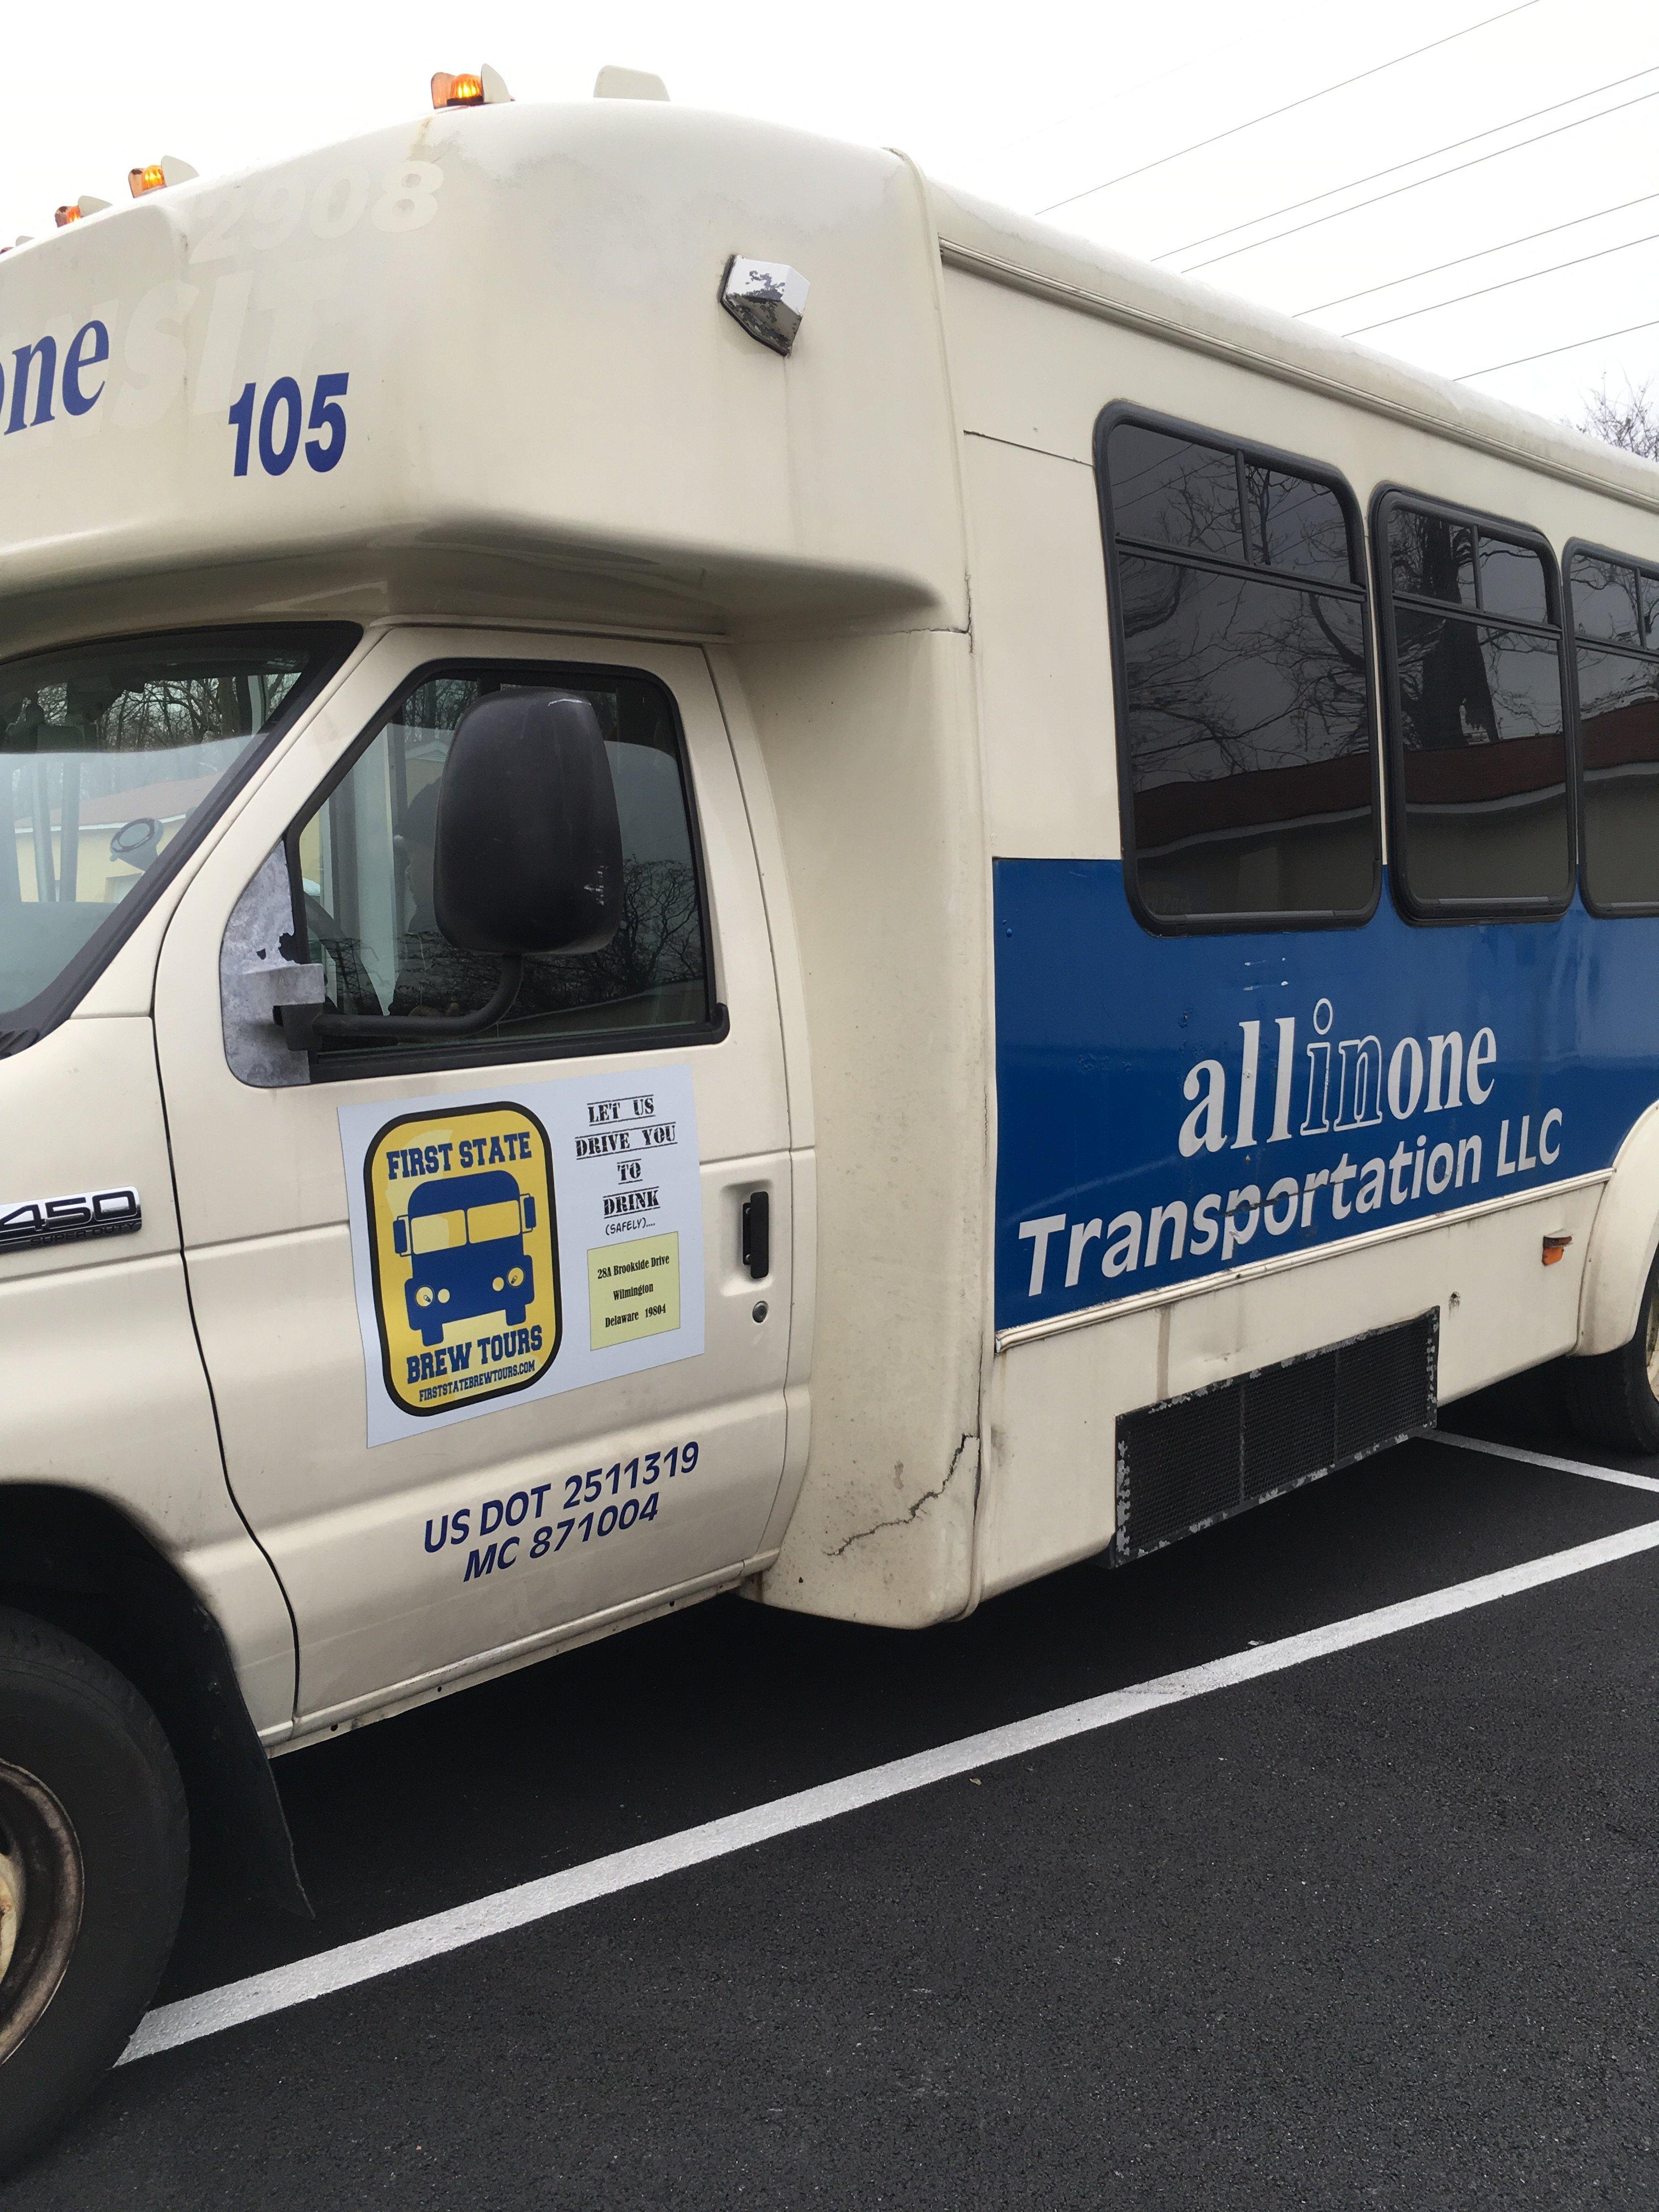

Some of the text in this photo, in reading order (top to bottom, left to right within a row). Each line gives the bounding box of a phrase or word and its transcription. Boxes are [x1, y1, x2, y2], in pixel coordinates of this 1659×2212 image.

[0, 320, 110, 436] ne
[228, 372, 349, 477] 105
[588, 1097, 654, 1123] LET US
[386, 1131, 532, 1180] FIRST STATE
[575, 1125, 675, 1157] DRIVE YOU
[617, 1162, 641, 1181] TO
[603, 1189, 659, 1216] DRINK
[1019, 1108, 1563, 1297] Transportation LLC
[597, 1255, 670, 1279] 28A Brookside Drive
[613, 1283, 653, 1301] Wilmington
[605, 1303, 667, 1328] Delaware 19804
[407, 1324, 543, 1384] BREW TOURS
[419, 1359, 535, 1402] FIRSTSTATEBREWTOURS.COM
[424, 1441, 699, 1553] US DOT 2511319
[463, 1492, 659, 1582] MC 871004
